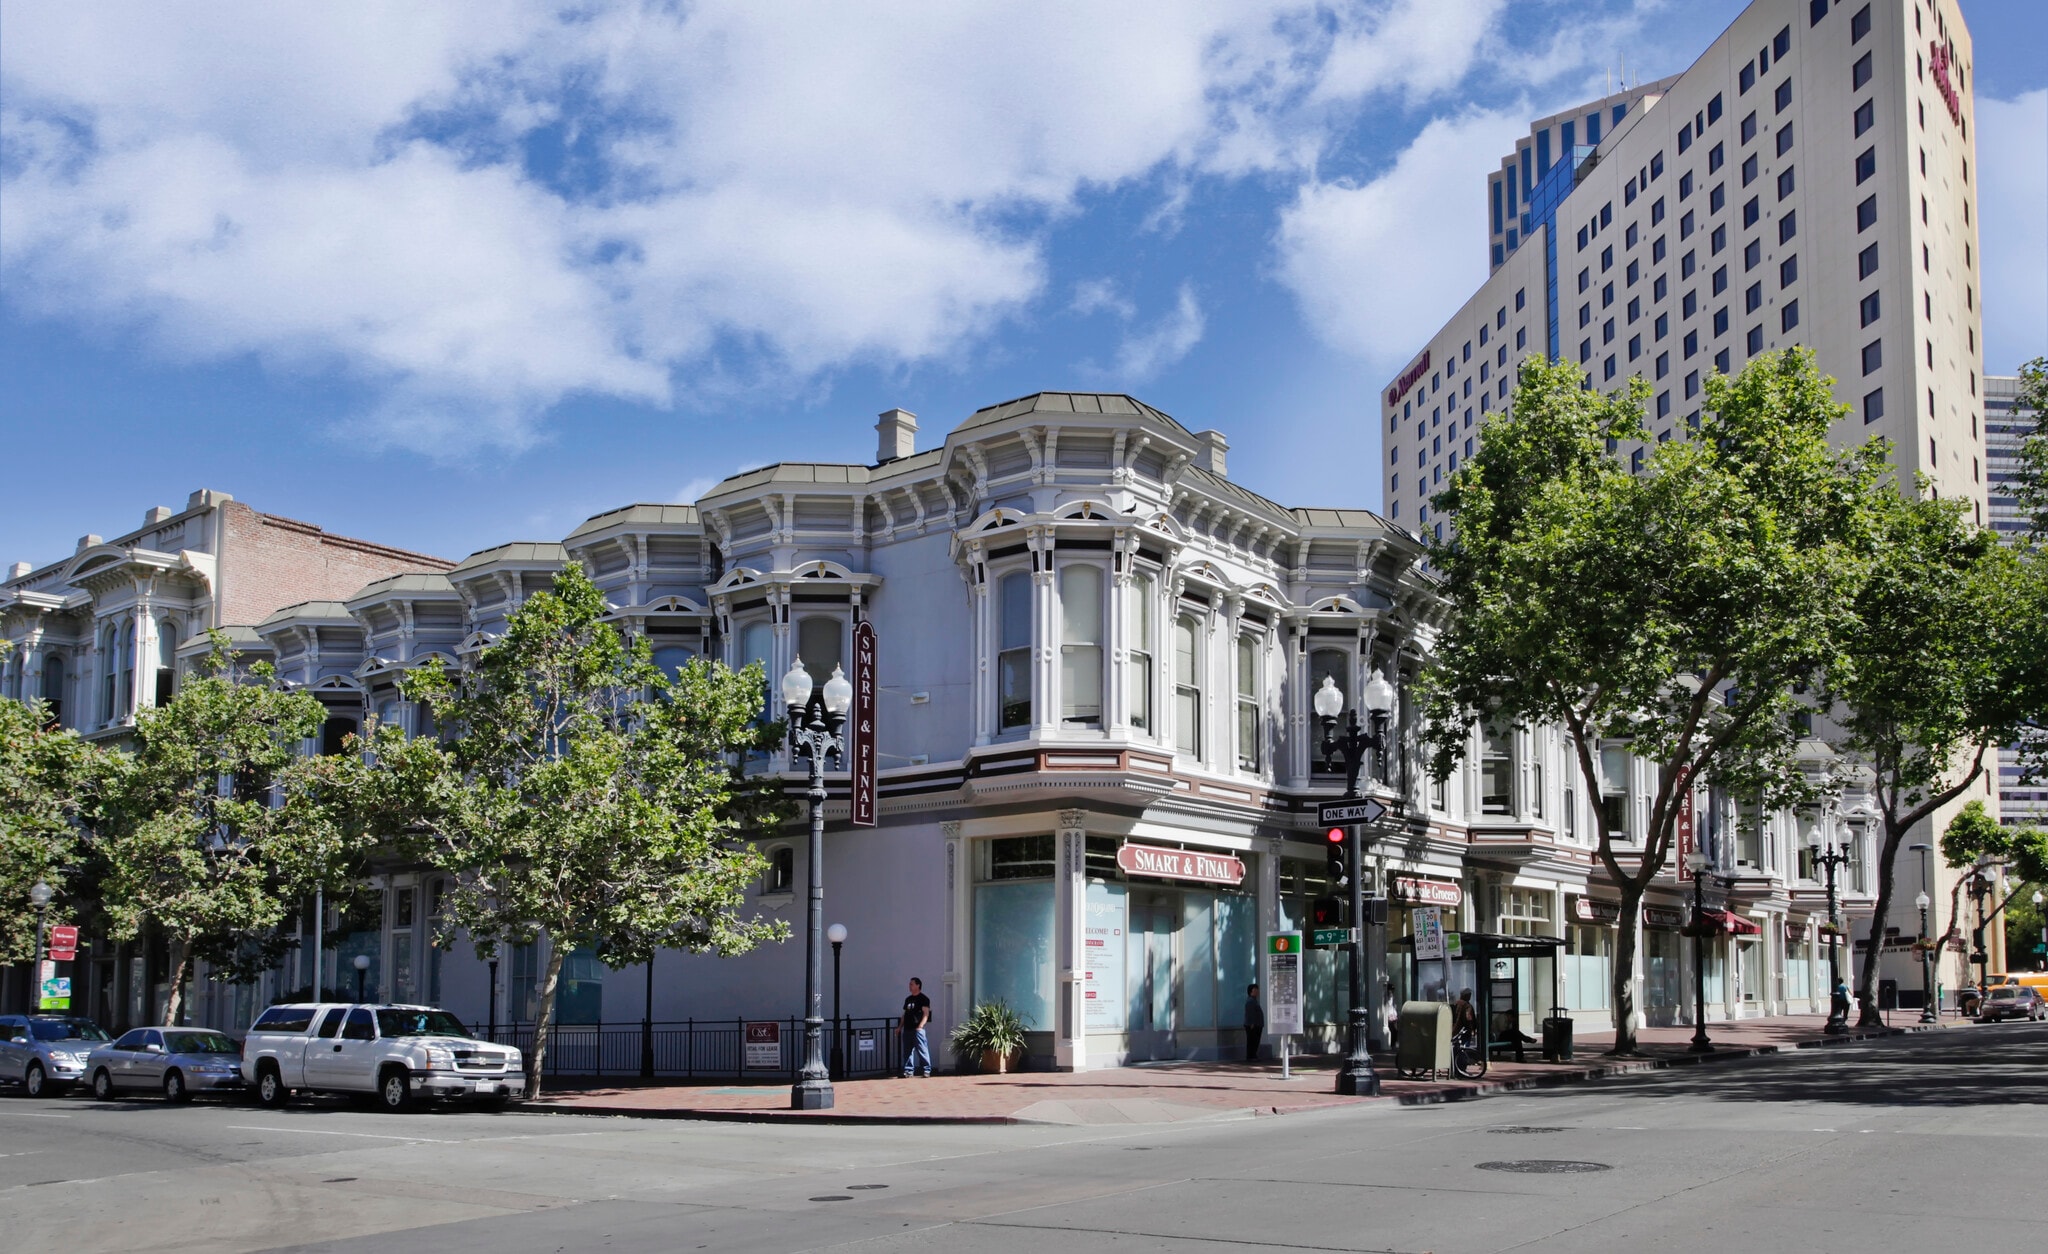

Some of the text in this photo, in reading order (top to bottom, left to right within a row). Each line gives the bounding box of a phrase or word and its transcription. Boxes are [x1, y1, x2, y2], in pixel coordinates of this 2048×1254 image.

[860, 636, 872, 818] SMART & FINAL
[1680, 773, 1690, 816] SRT
[1325, 806, 1367, 820] ONE WAY
[1681, 821, 1690, 830] &
[1135, 848, 1231, 879] SMART & FINAL
[1432, 885, 1458, 901] Grocers
[1086, 927, 1108, 935] ELCOME!
